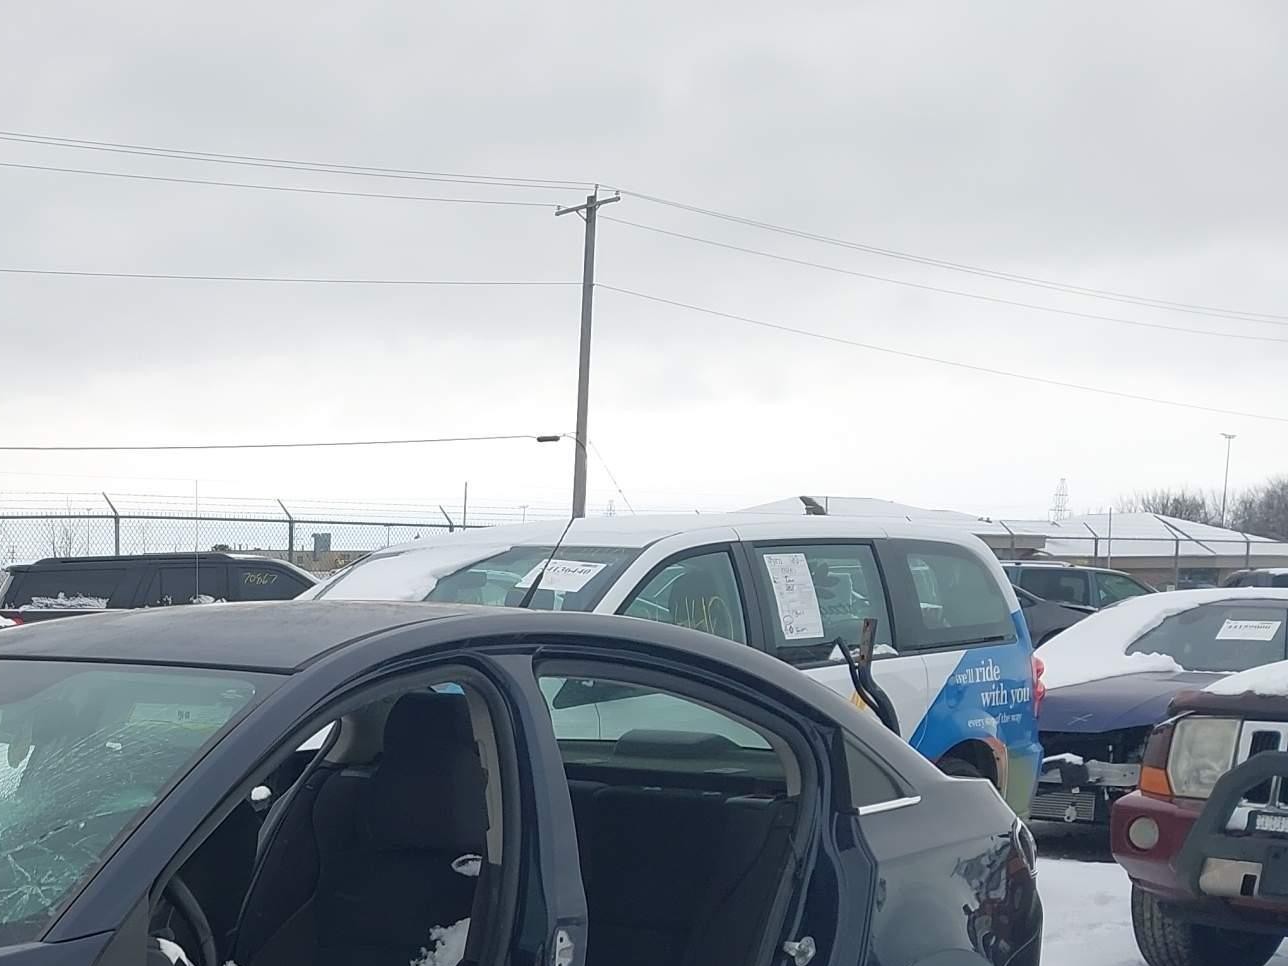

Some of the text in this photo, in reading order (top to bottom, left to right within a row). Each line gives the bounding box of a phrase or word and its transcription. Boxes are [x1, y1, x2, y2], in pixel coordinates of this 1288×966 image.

[956, 659, 1000, 684] we'll ride
[981, 683, 1030, 709] with you
[967, 719, 985, 728] every
